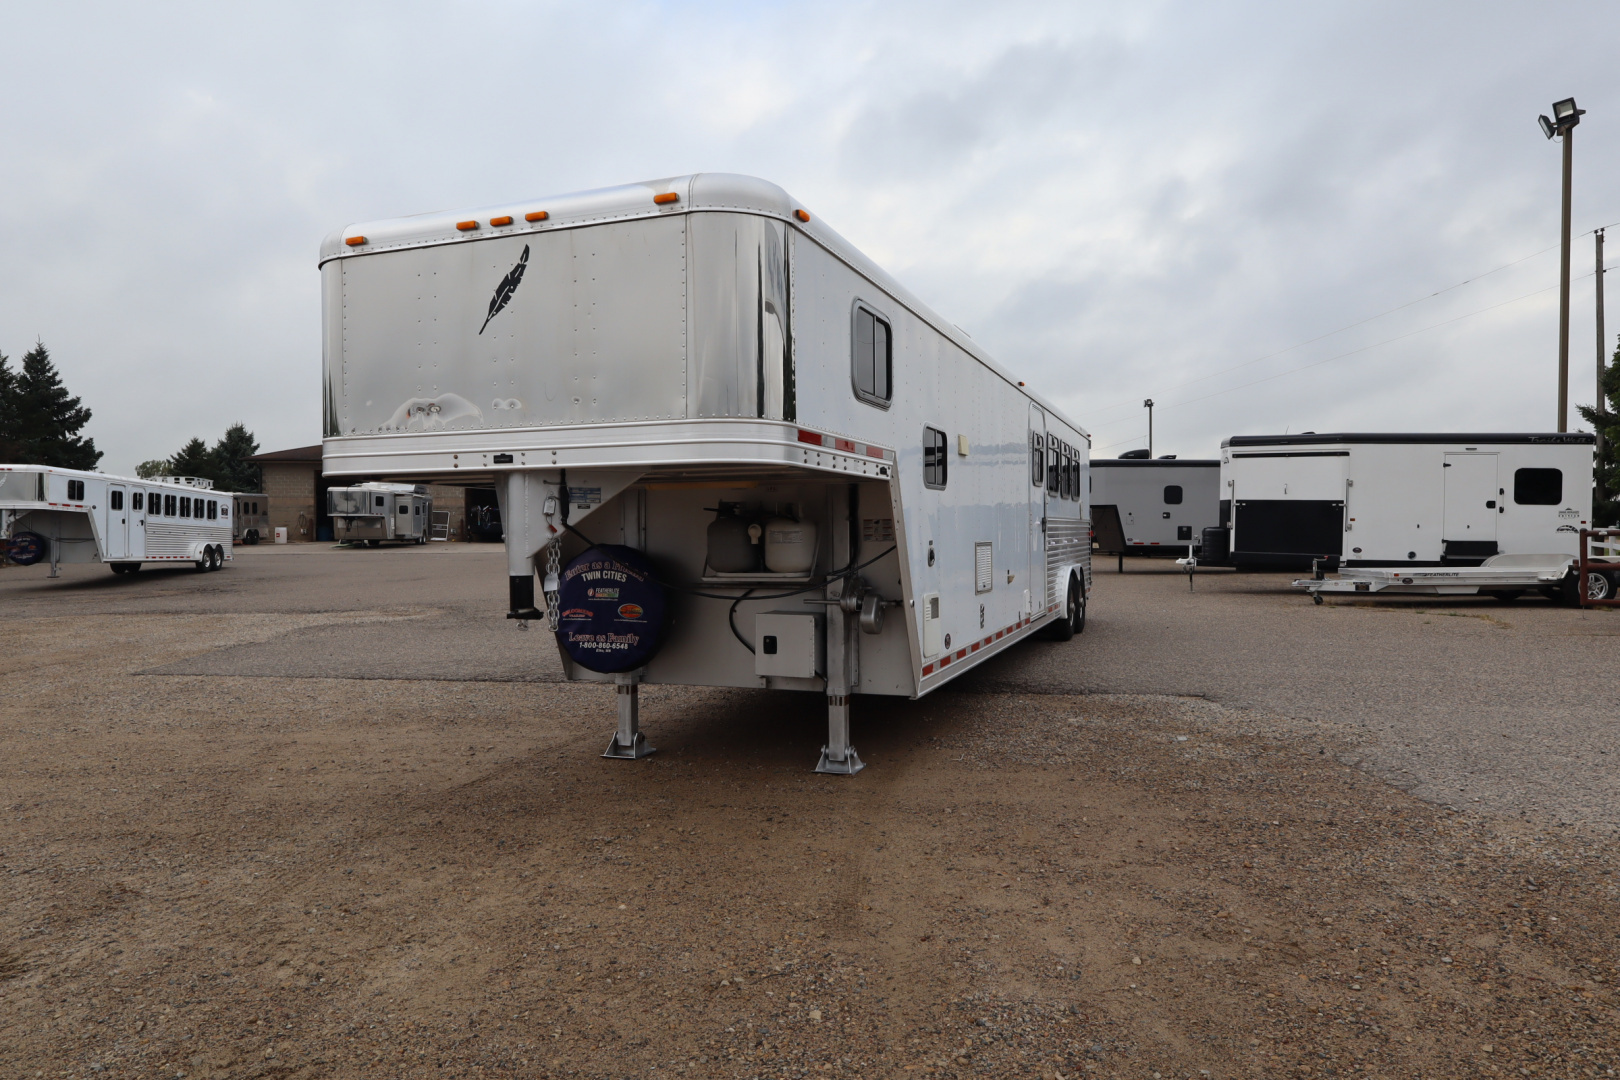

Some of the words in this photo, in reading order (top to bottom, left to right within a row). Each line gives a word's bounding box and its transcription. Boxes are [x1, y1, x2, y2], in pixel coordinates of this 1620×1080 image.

[564, 562, 590, 581] Enter
[592, 561, 603, 570] as
[604, 561, 611, 570] a
[581, 570, 601, 582] TWIN
[602, 570, 628, 583] CITIES
[568, 631, 595, 642] Leave
[596, 634, 607, 643] as
[607, 632, 640, 647] Family
